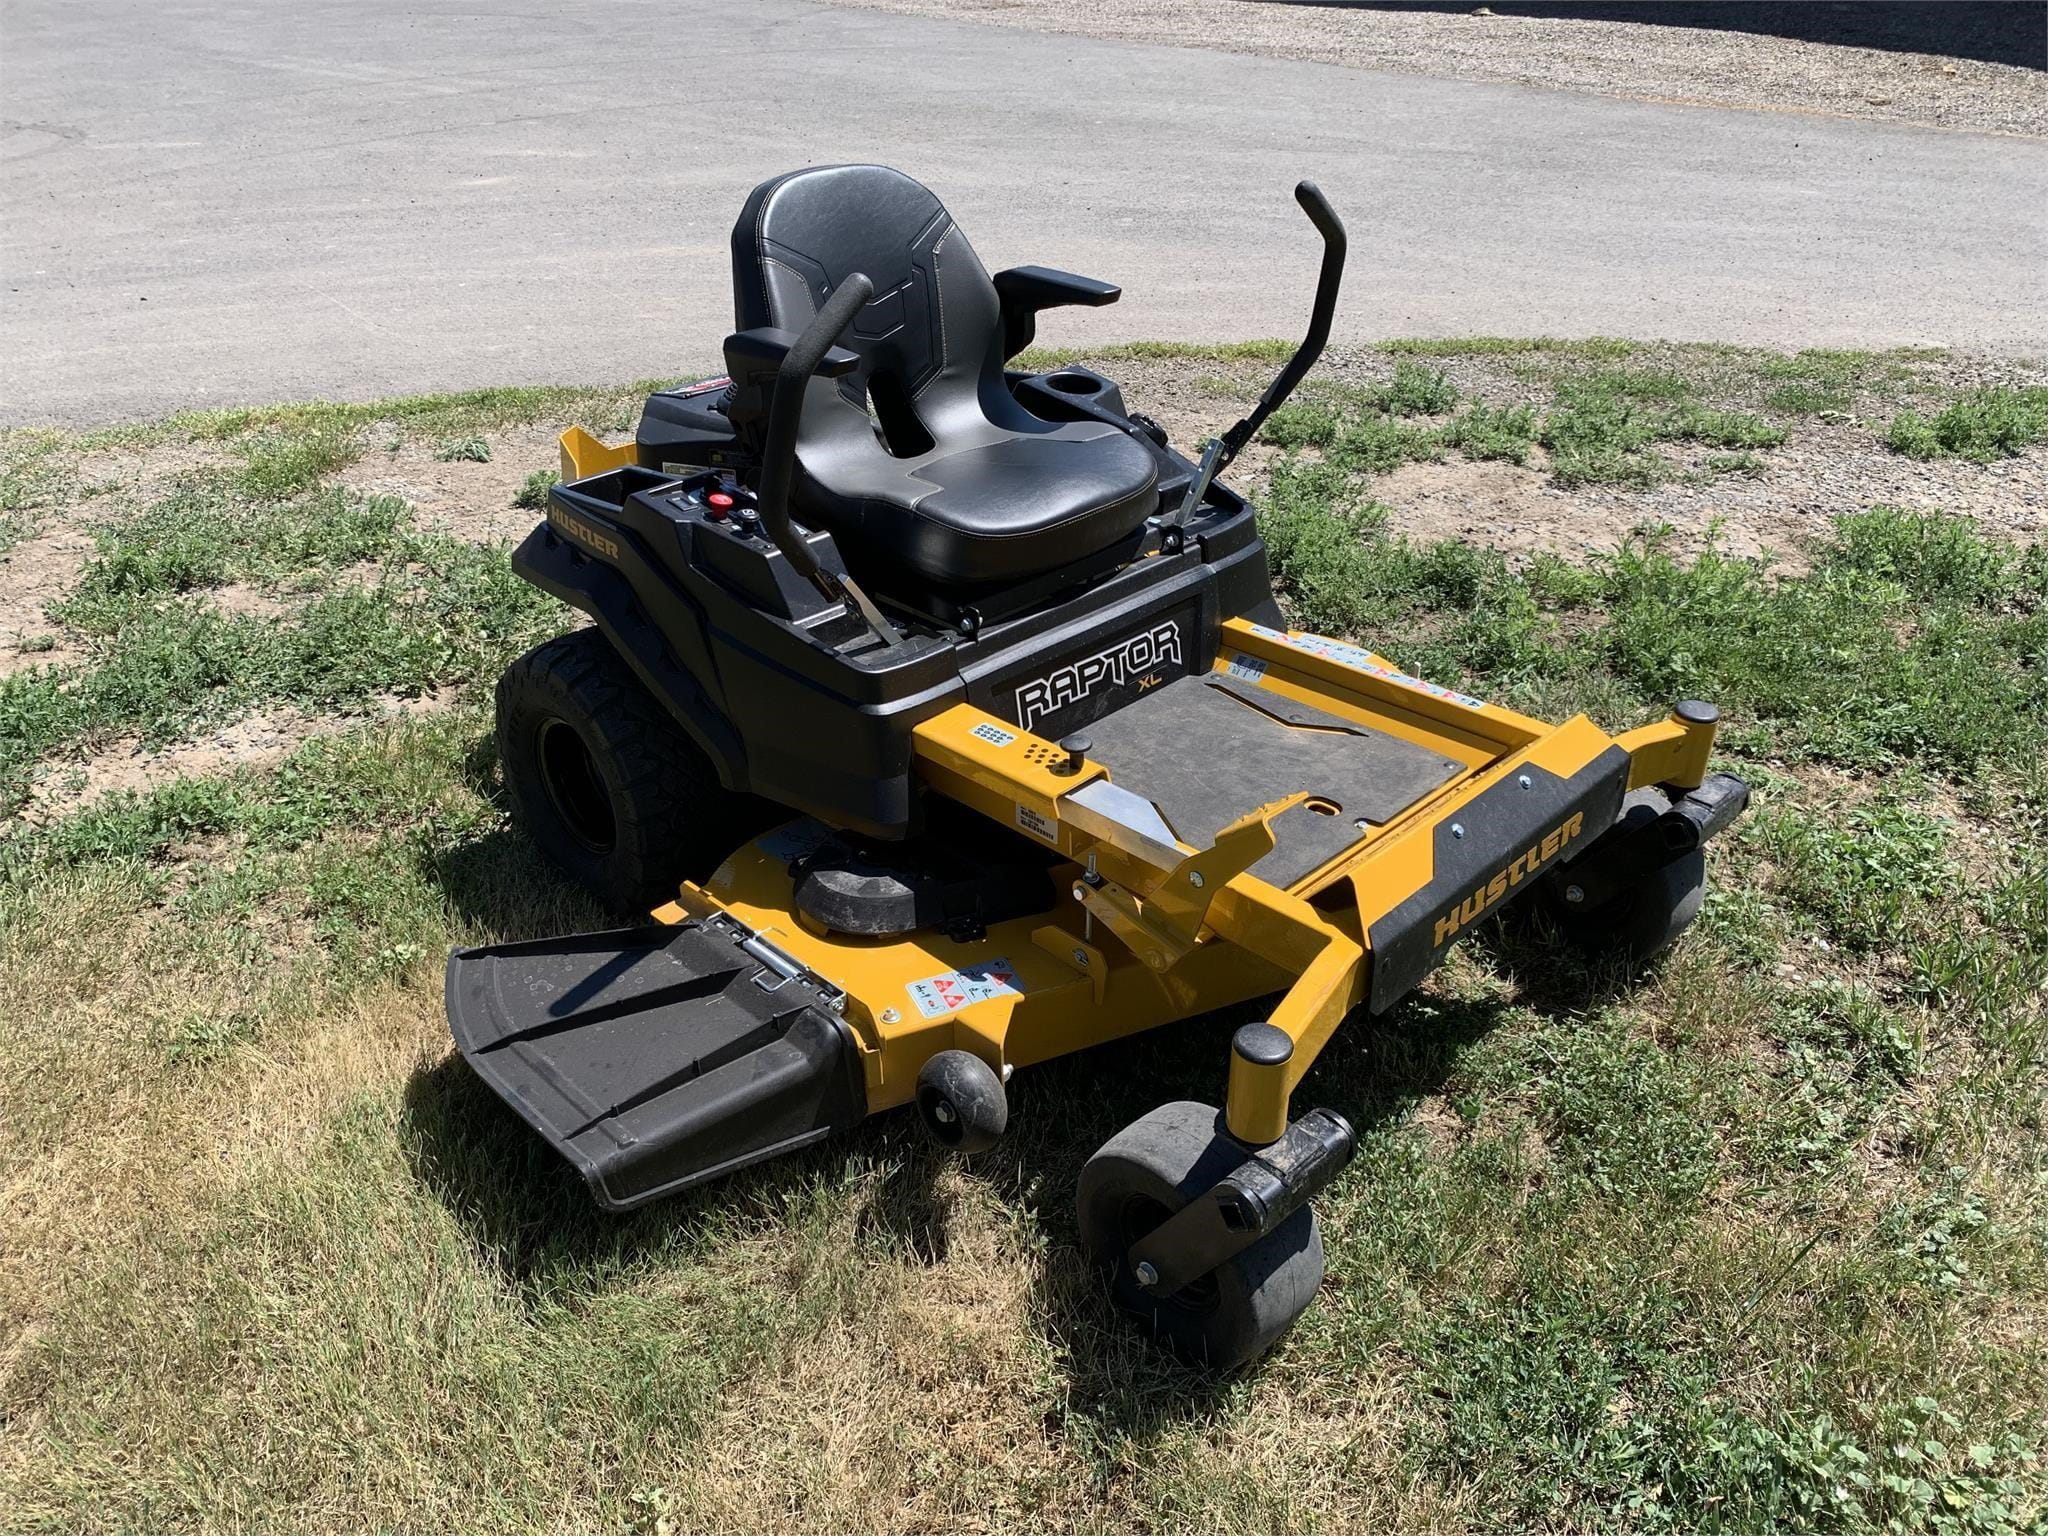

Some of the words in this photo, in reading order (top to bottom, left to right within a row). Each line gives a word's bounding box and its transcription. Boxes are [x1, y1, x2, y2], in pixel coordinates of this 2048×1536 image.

[550, 505, 620, 560] HUSTLER
[1015, 619, 1183, 733] RAPTOR
[1138, 672, 1162, 694] XL
[1434, 811, 1584, 948] HUSTLER
